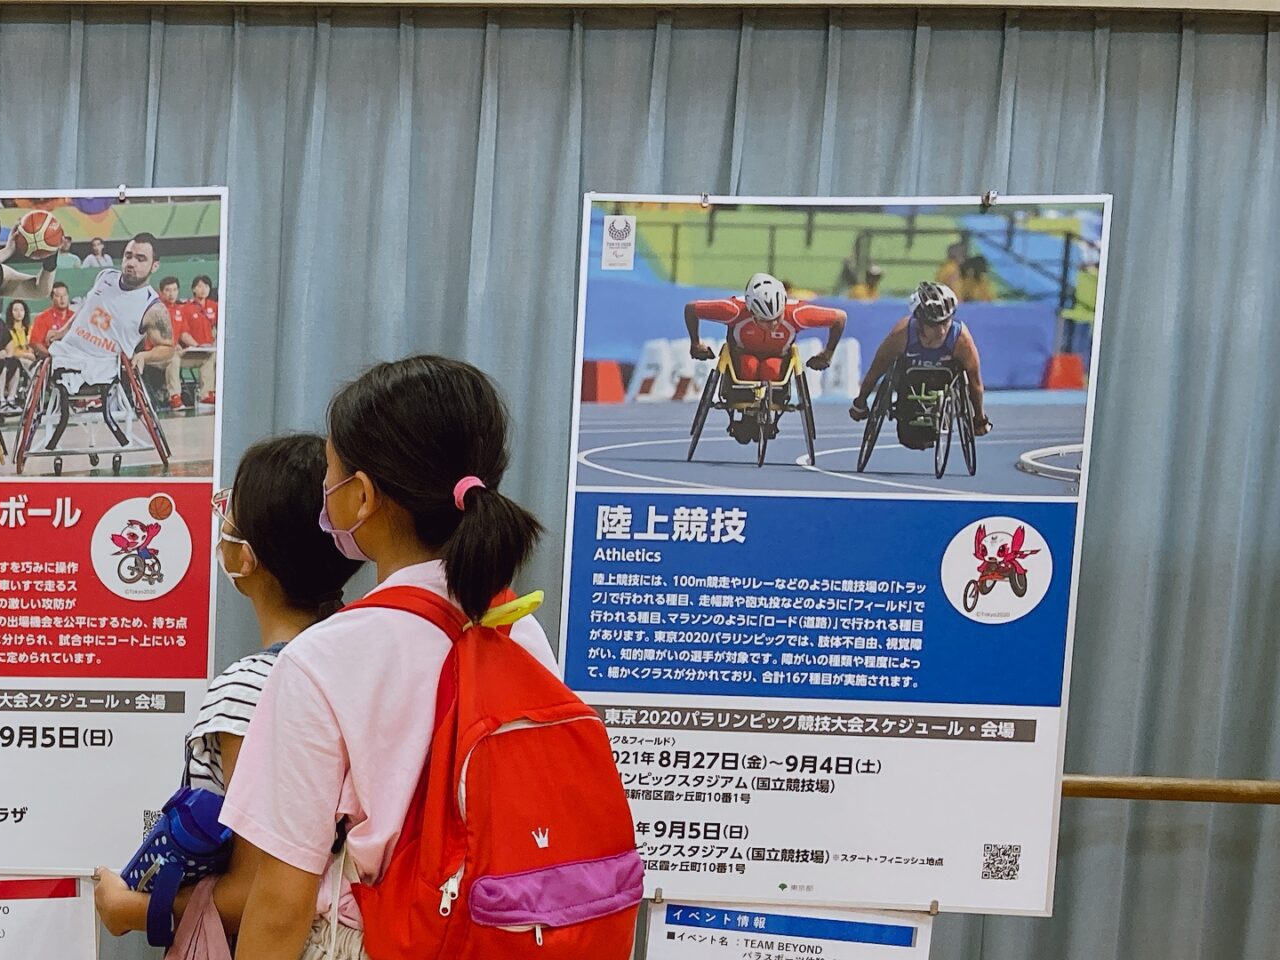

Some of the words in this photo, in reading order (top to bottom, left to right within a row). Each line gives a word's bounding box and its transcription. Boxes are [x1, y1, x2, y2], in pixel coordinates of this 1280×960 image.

[596, 504, 748, 544] 陸上競技
[593, 547, 662, 562] Athletics
[604, 708, 1015, 739] 東京2020パラリンピック競技大会スケジュール・会場
[672, 908, 766, 929] イベント情報
[777, 941, 823, 955] BEYOND
